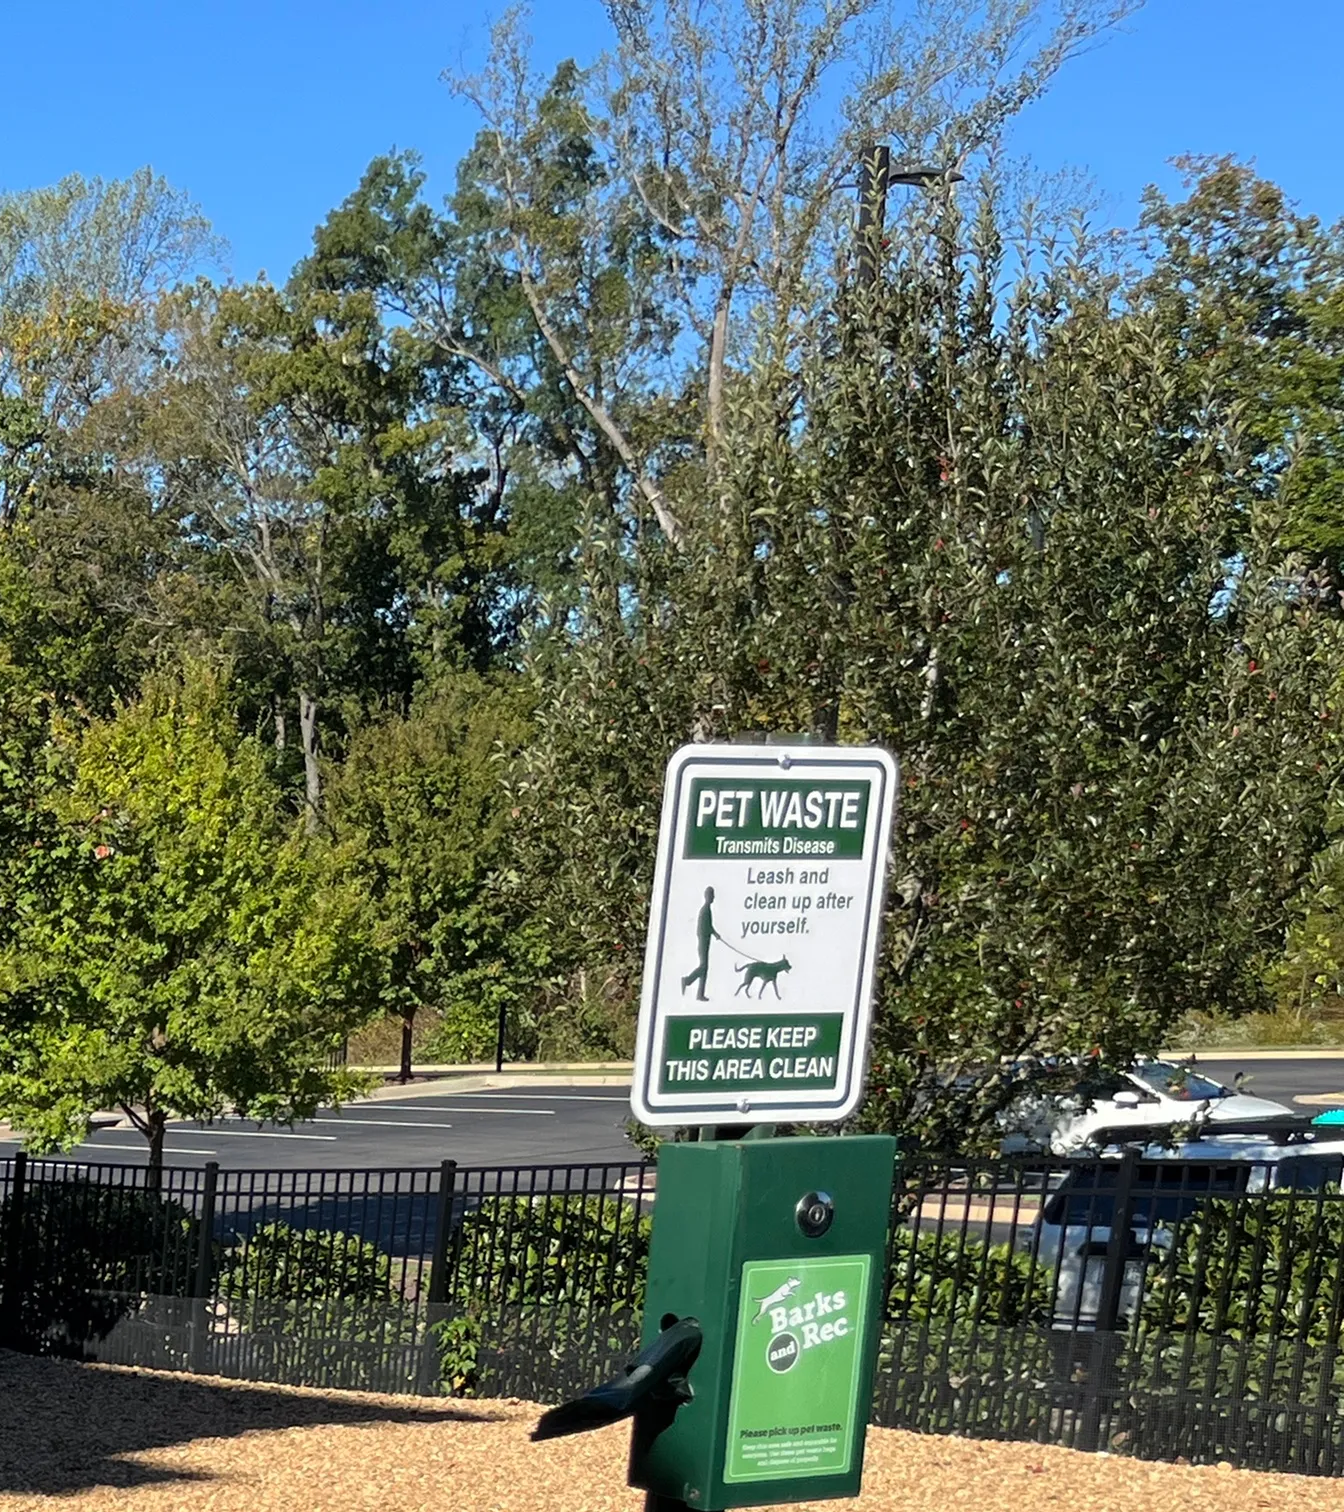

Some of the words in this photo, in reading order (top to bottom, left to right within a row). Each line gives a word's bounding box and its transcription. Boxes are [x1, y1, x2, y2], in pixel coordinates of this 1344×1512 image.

[696, 791, 753, 828] PET
[760, 792, 861, 829] WASTE
[715, 837, 780, 855] Transmits
[783, 837, 835, 854] Disease
[747, 867, 795, 885] Leash
[799, 867, 829, 884] and
[744, 892, 786, 909] clean
[792, 896, 811, 914] up
[816, 893, 853, 909] after
[740, 917, 810, 939] yourself.
[688, 1028, 762, 1049] PLEASE
[765, 1027, 817, 1048] KEEP
[666, 1060, 709, 1082] THIS
[712, 1059, 764, 1080] AREA
[769, 1057, 833, 1079] CLEAN
[769, 1290, 845, 1334] Barks
[770, 1340, 797, 1361] and
[802, 1317, 848, 1350] Rec
